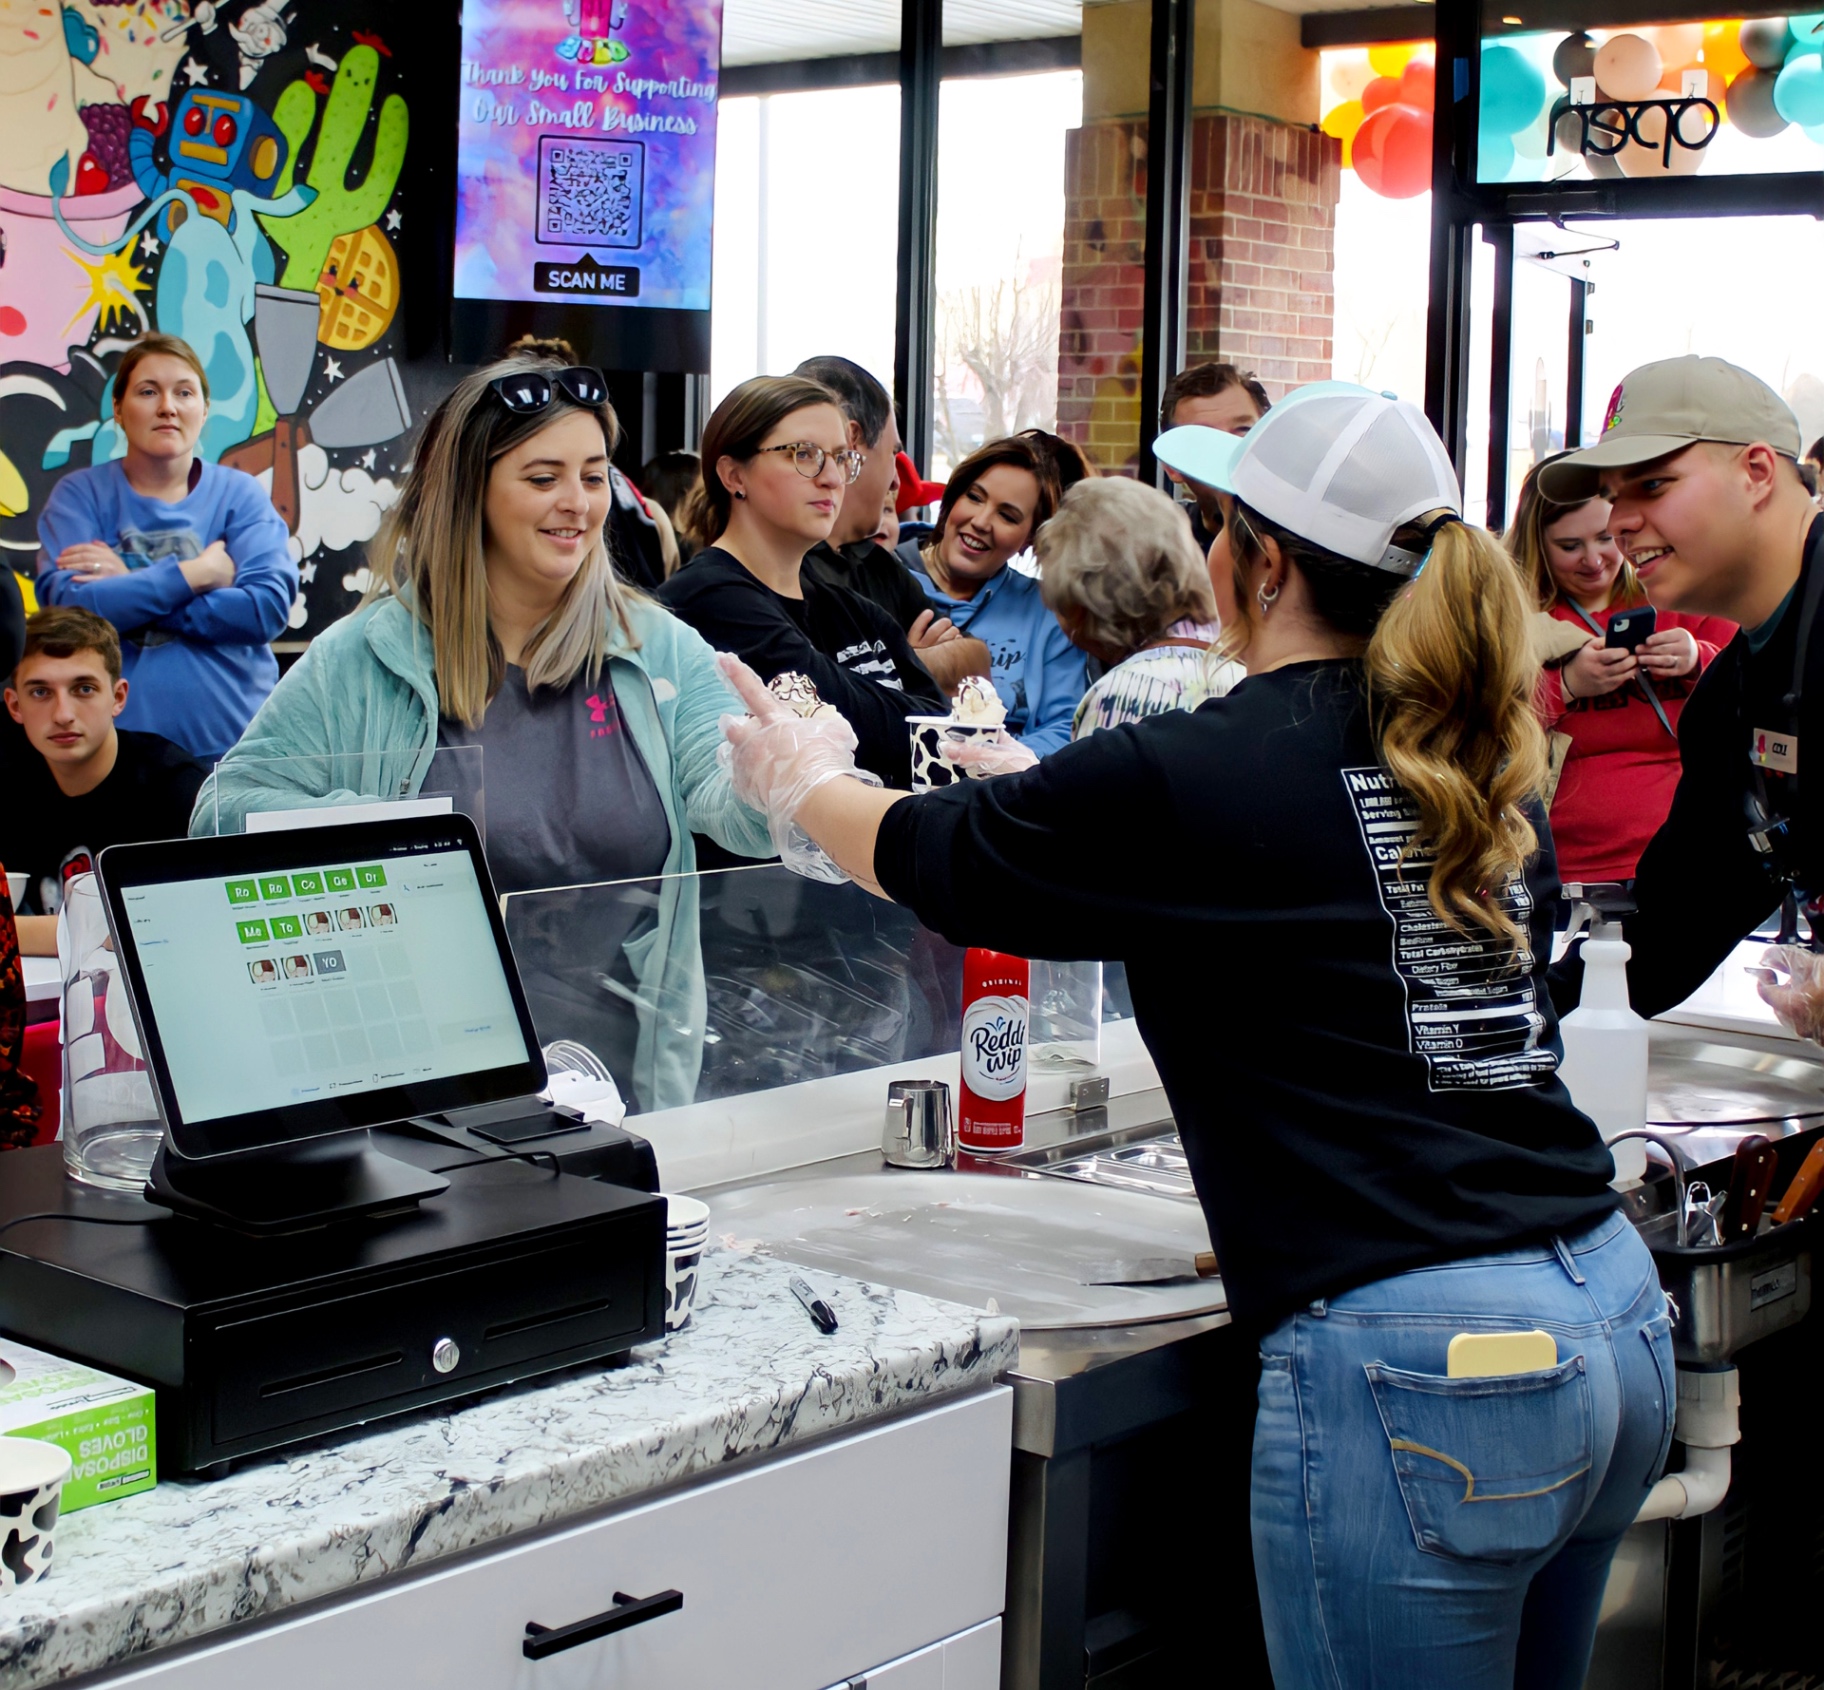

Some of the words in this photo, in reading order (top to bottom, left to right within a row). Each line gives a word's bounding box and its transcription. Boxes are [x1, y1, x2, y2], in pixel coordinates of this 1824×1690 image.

[462, 63, 525, 86] Thank
[529, 69, 569, 91] You
[575, 70, 608, 94] For
[613, 71, 717, 103] Supporting
[473, 97, 520, 127] Our
[525, 99, 595, 129] Small
[602, 104, 699, 136] Business
[548, 270, 596, 289] SCAN
[600, 273, 626, 291] ME
[1349, 773, 1393, 792] Nutr
[970, 1020, 1026, 1062] Reddi
[1415, 1025, 1453, 1035] Vitamin
[1416, 1040, 1455, 1050] Vitamin
[79, 1424, 148, 1458] GLOVES
